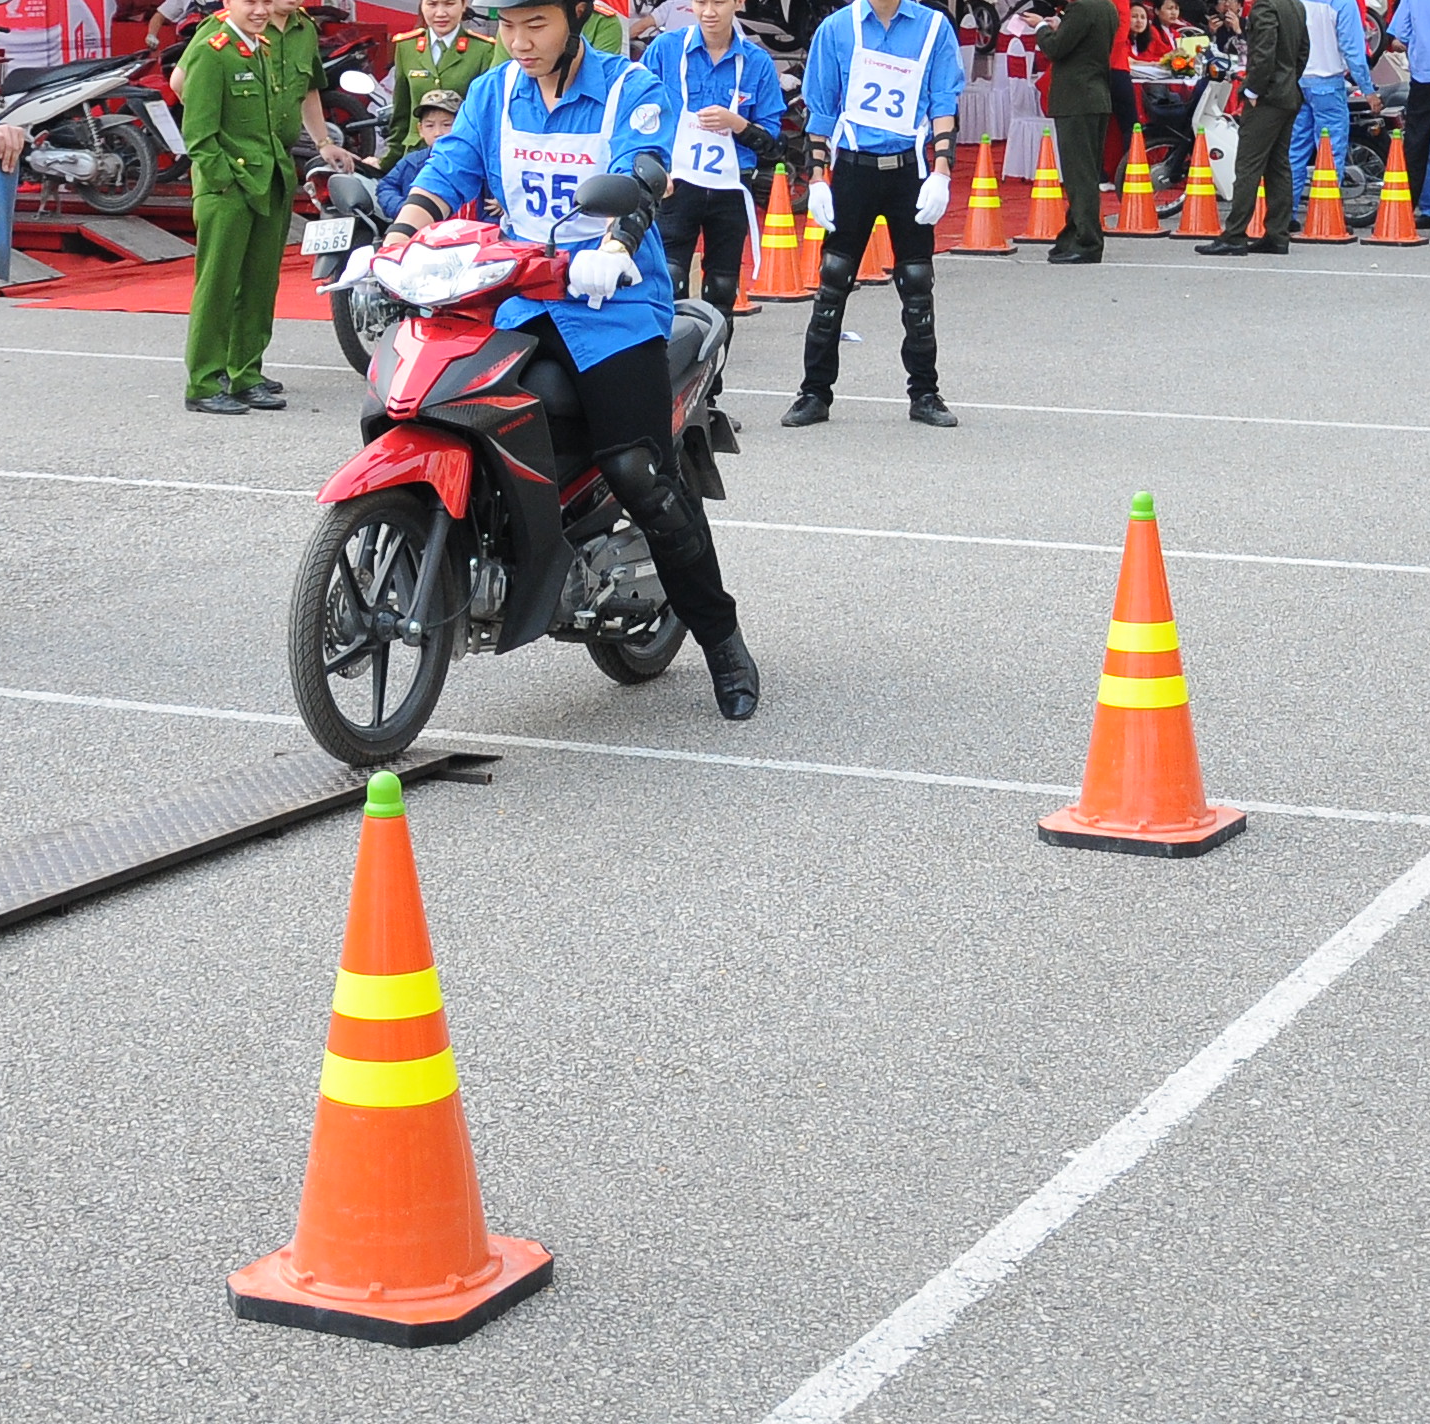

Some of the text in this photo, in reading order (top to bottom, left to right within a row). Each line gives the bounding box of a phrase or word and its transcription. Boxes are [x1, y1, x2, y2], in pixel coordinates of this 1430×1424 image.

[860, 82, 906, 119] 23
[514, 148, 596, 165] HONDA
[690, 143, 725, 175] 12
[522, 170, 580, 221] 55
